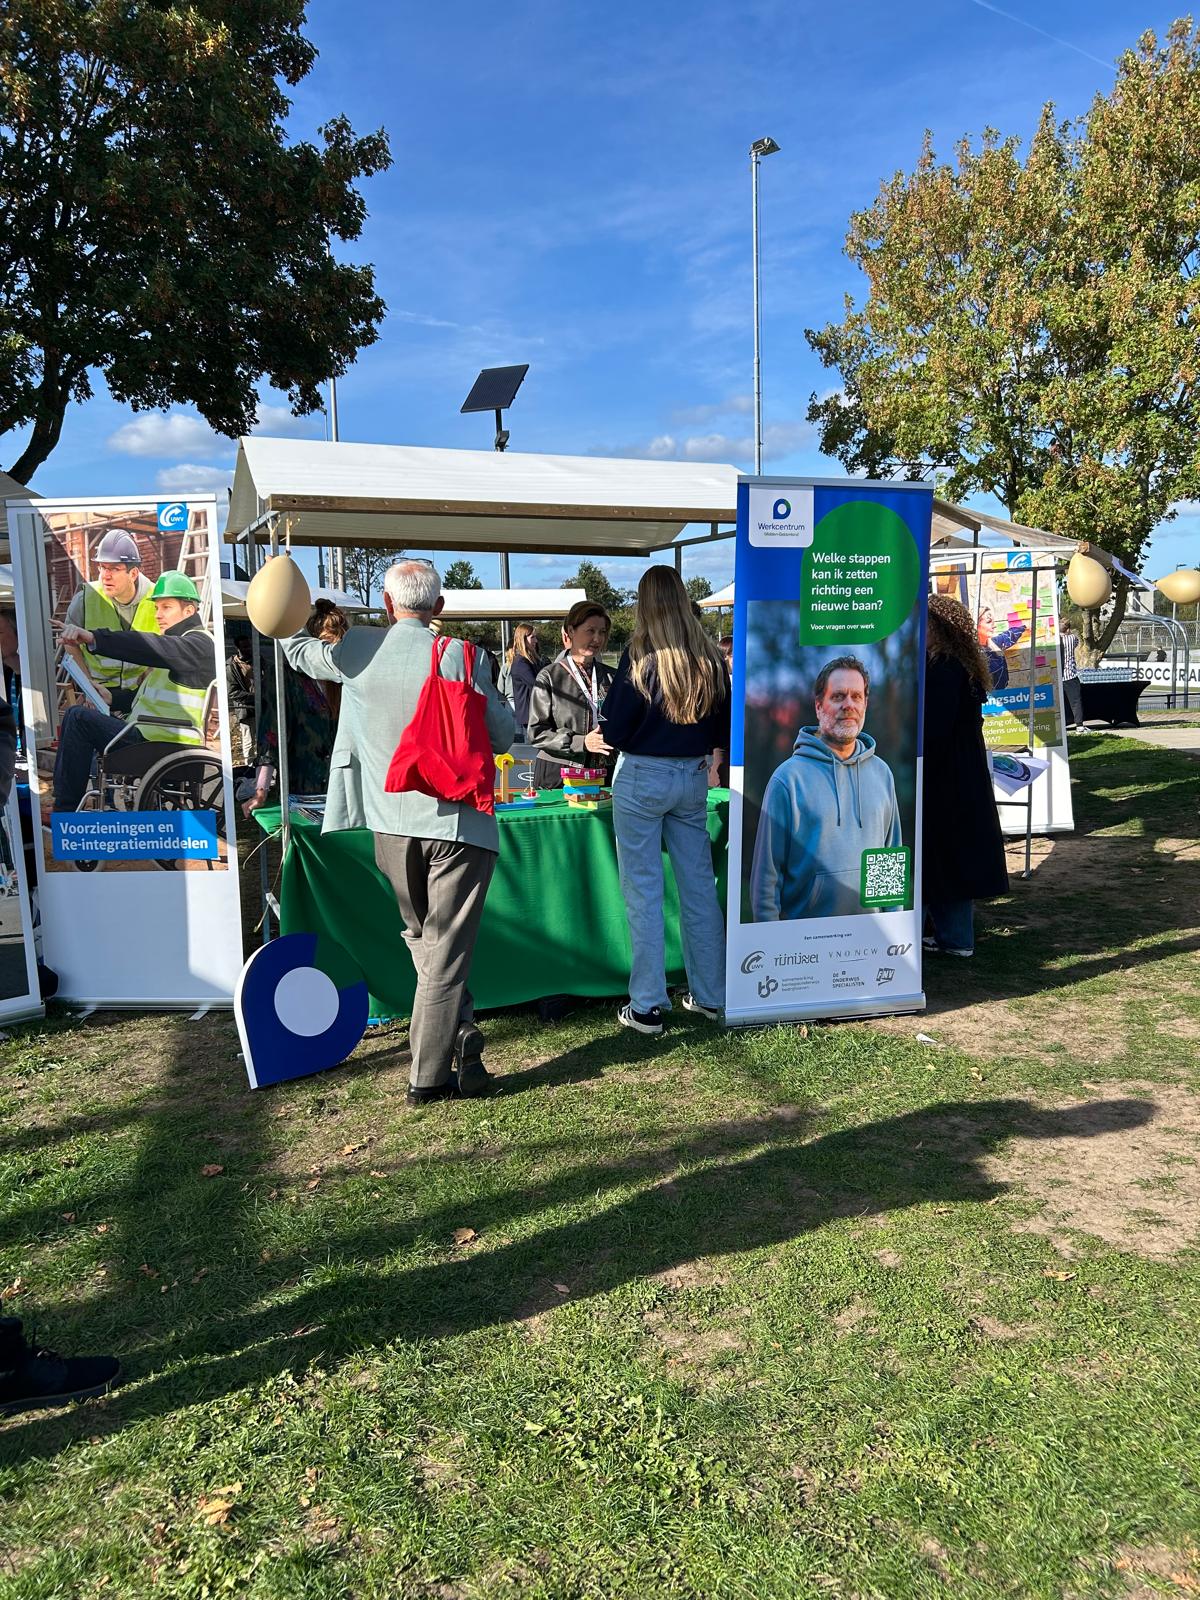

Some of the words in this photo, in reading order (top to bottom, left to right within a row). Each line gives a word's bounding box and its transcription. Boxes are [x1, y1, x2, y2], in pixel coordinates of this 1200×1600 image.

[757, 522, 805, 531] Werkcentrum
[812, 552, 847, 564] Welke
[848, 553, 891, 566] stappen
[811, 568, 831, 580] kan
[834, 568, 843, 579] ik
[845, 569, 878, 579] zetten
[811, 584, 852, 597] richting
[811, 600, 850, 611] nieuwe
[852, 600, 883, 611] baan?
[59, 821, 154, 836] Voorzieningen
[158, 822, 174, 833] en
[61, 837, 209, 853] Re-integratiemiddelen
